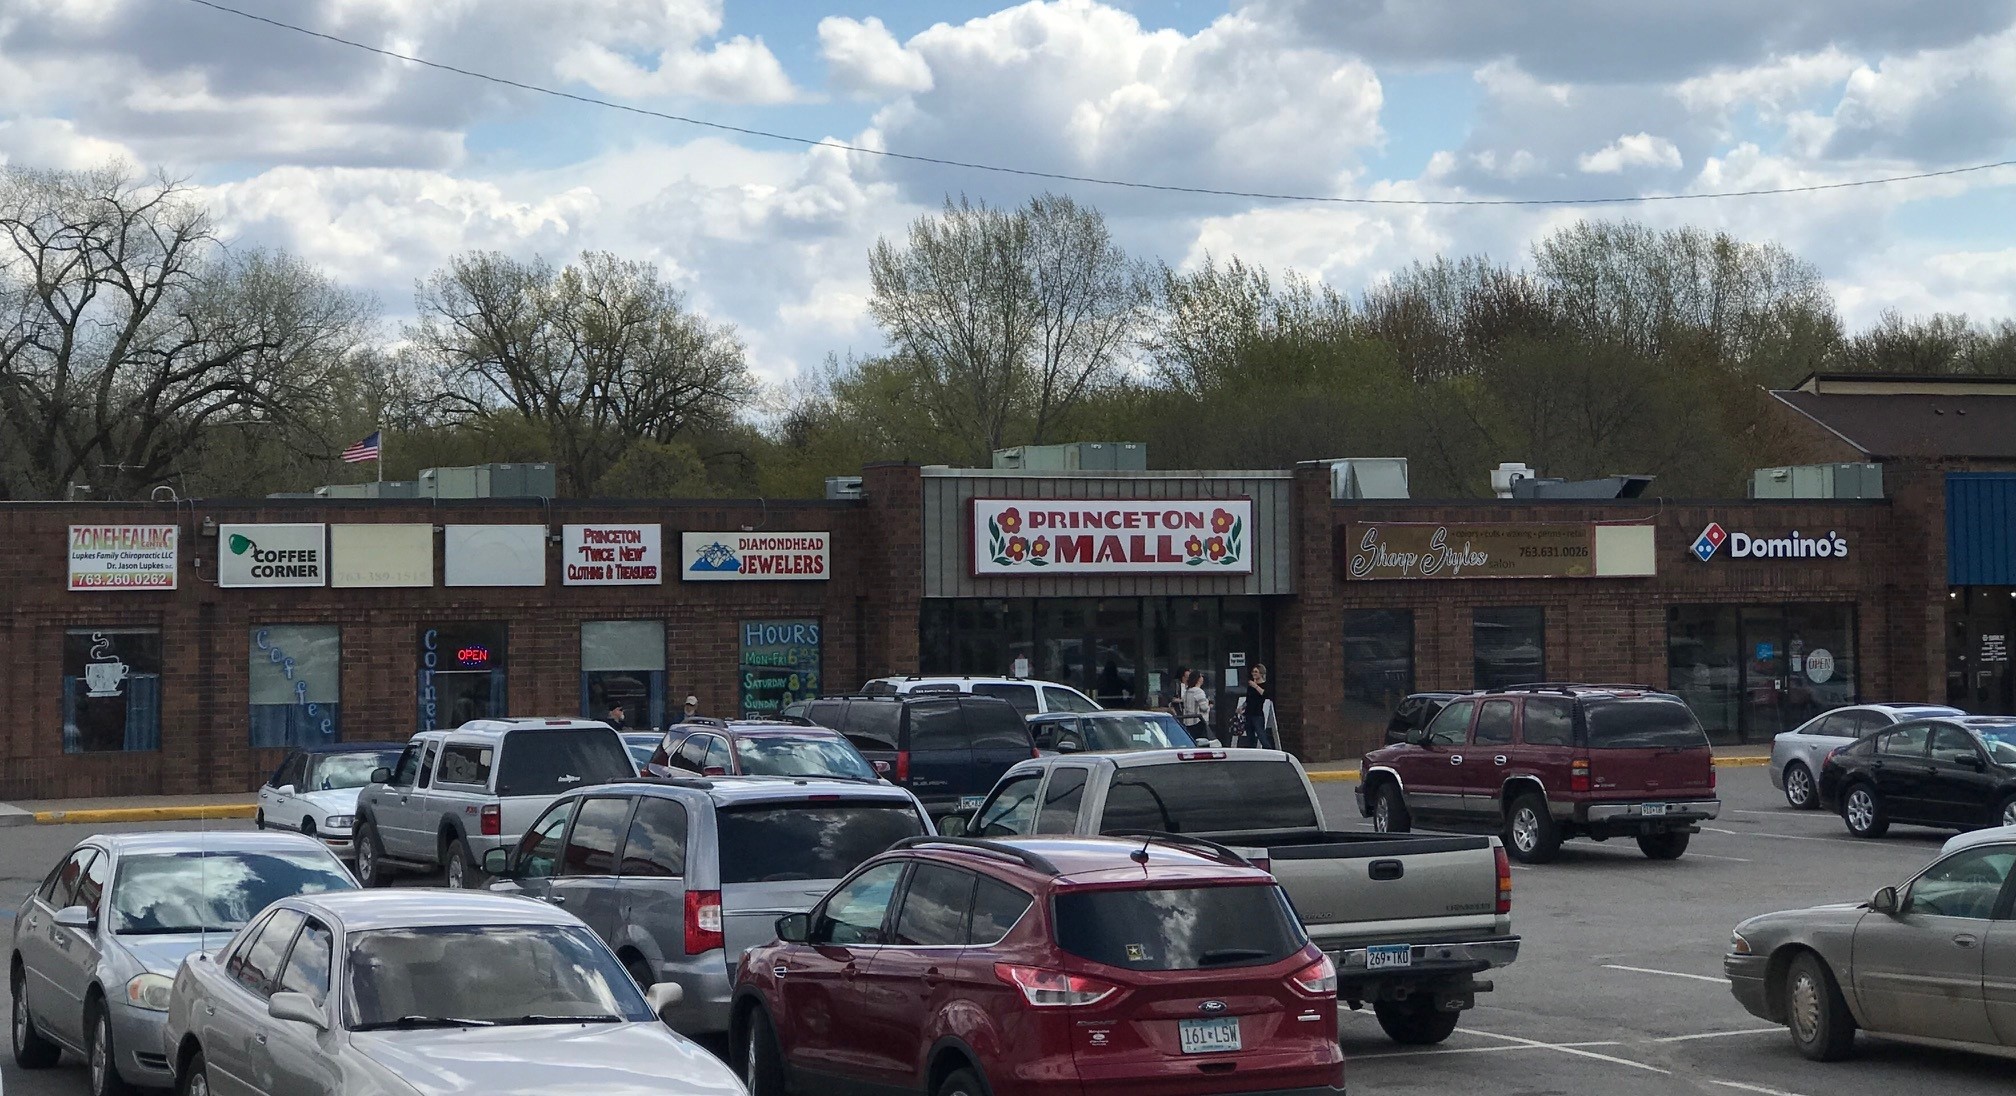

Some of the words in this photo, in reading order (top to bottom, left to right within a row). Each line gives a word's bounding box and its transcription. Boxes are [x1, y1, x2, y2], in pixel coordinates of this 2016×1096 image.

[1028, 510, 1205, 530] PRINCETON
[72, 528, 174, 550] ZONEHEALING
[738, 538, 824, 551] DIAMONDHEAD
[1731, 530, 1848, 558] Domino's
[1054, 534, 1184, 563] MALL
[1350, 527, 1418, 577] Sharp
[1420, 526, 1489, 576] Styles
[1519, 546, 1589, 558] 763.631.0026
[72, 552, 96, 560] Lupkes
[96, 552, 119, 560] Family
[120, 552, 160, 560] Chiropractic
[254, 549, 317, 563] COFFEE
[118, 562, 138, 570] Jason
[139, 562, 164, 570] Lupkes
[738, 555, 824, 574] JEWELERS
[1488, 558, 1516, 569] salon
[250, 565, 318, 578] CORNER
[606, 564, 613, 580] &
[77, 573, 167, 585] 763.260.0262
[745, 623, 819, 646] HOURS
[457, 649, 488, 661] OPEN
[1808, 657, 1832, 670] OPEN
[1369, 952, 1386, 966] 269
[1184, 1027, 1207, 1045] 161
[1213, 1025, 1238, 1043] LSW
